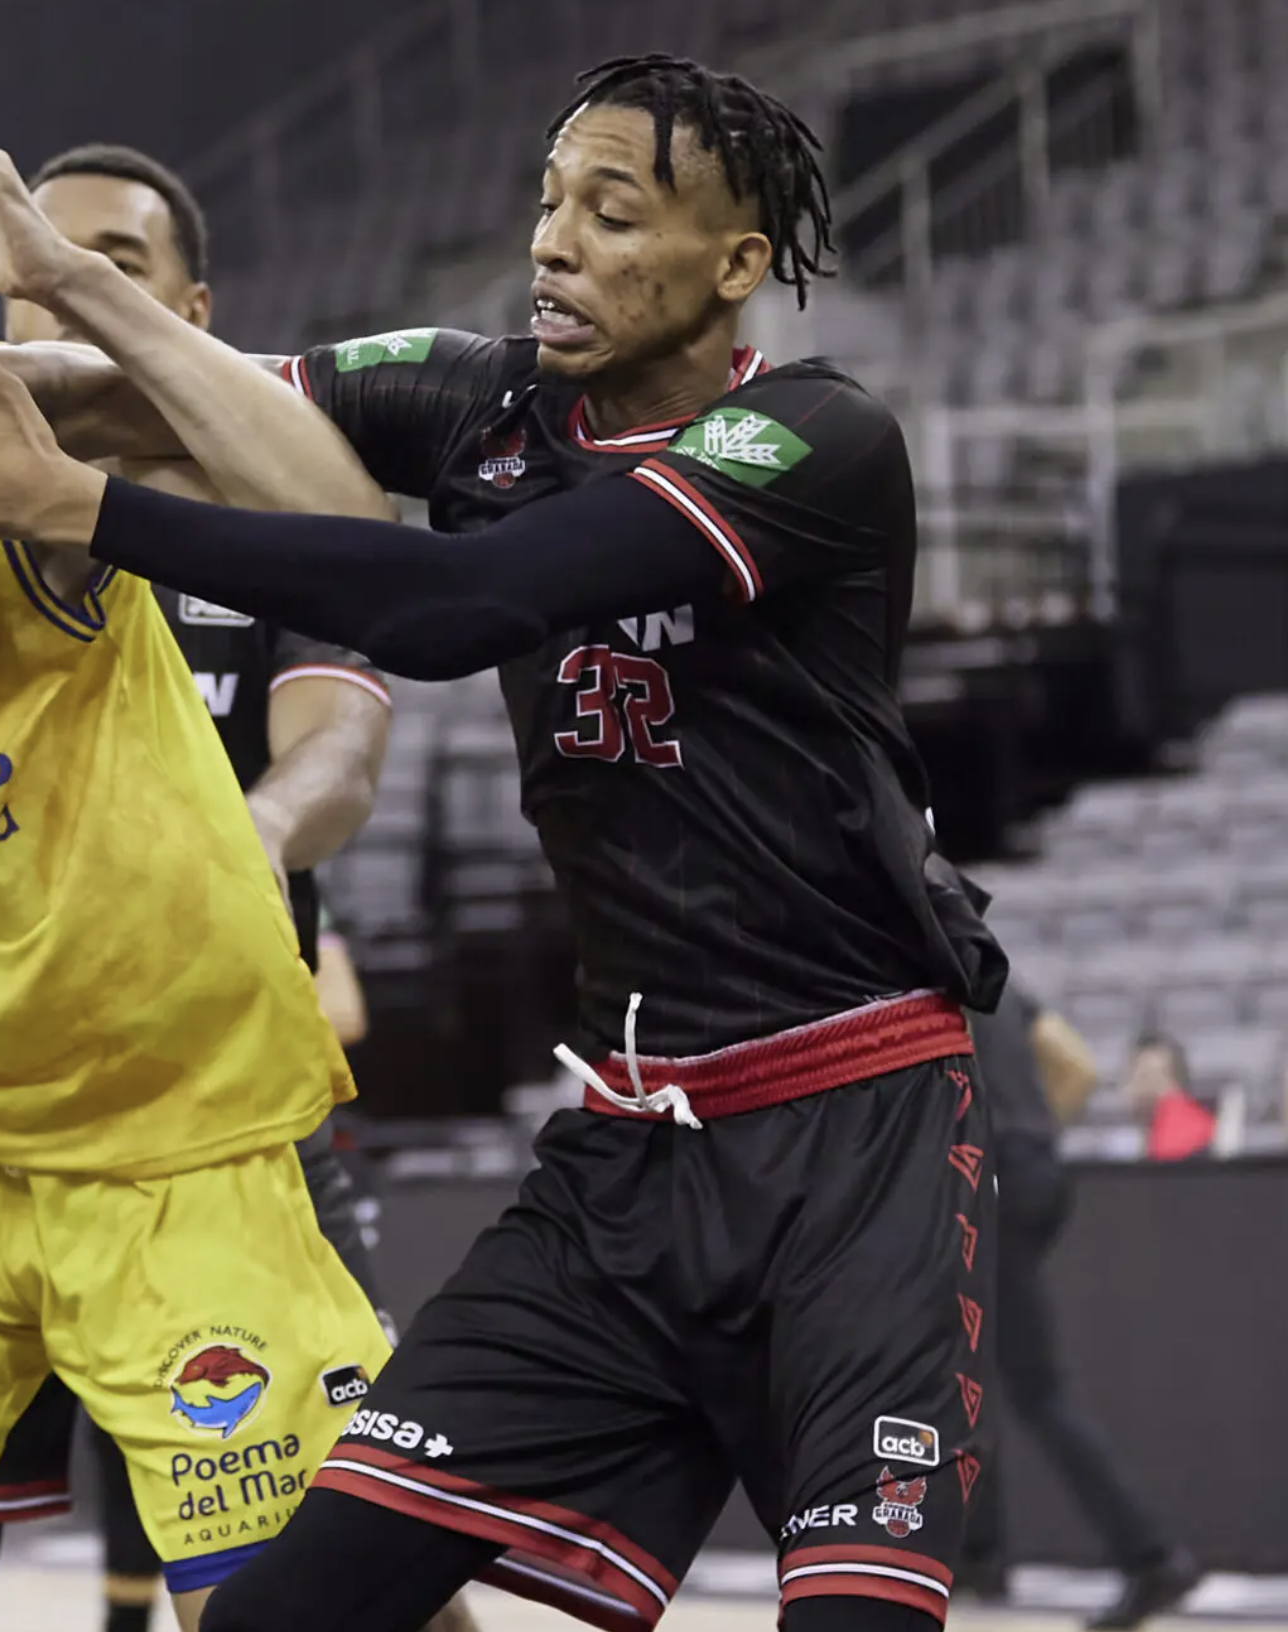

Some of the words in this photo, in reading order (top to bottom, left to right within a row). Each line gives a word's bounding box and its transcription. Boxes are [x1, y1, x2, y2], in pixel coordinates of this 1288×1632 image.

[554, 643, 685, 770] 32
[153, 1329, 202, 1389] DISCOVER
[210, 1325, 268, 1352] NATURE
[331, 1378, 368, 1402] acb
[171, 1433, 300, 1487] Poema
[881, 1434, 925, 1458] acb
[178, 1484, 230, 1521] del
